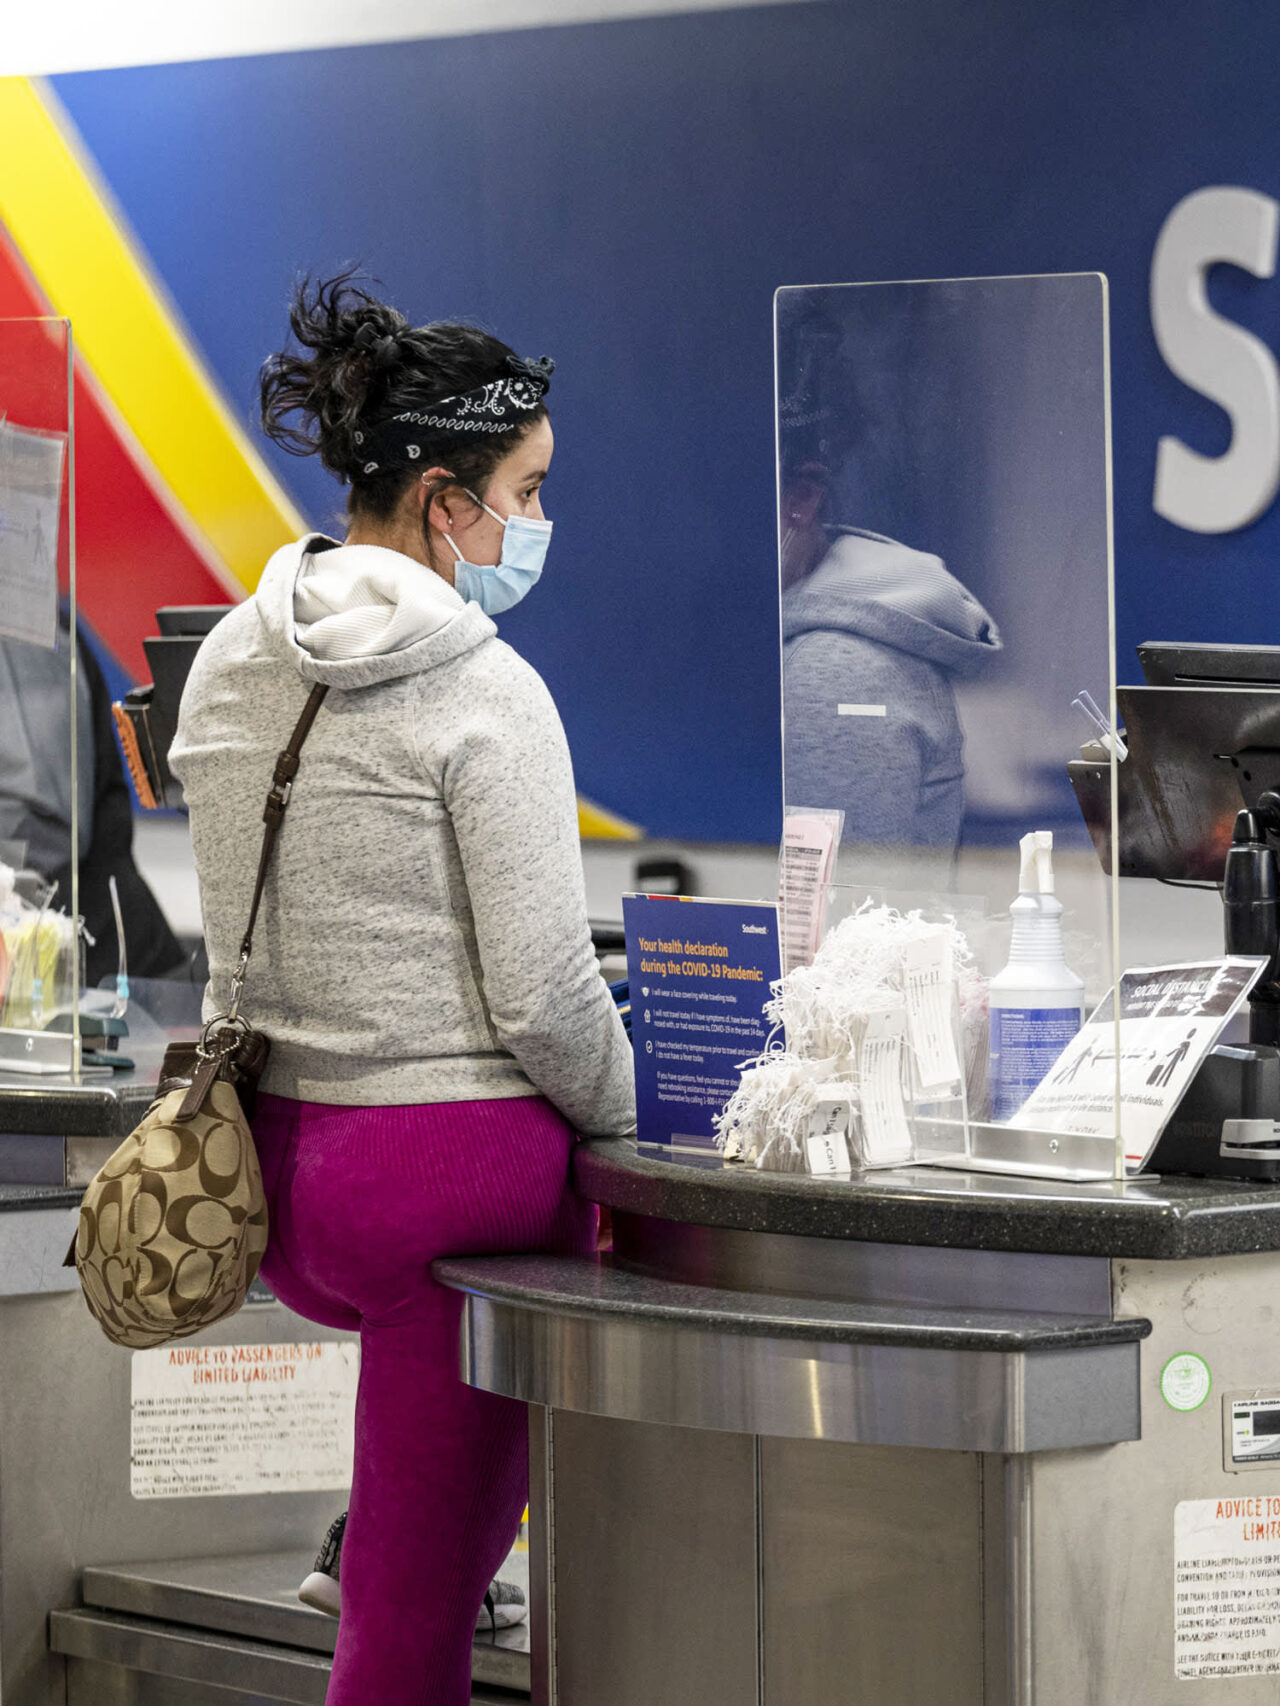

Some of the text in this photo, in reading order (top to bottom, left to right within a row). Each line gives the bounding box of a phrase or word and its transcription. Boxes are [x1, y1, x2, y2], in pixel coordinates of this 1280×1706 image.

[742, 923, 767, 934] Southwest
[638, 937, 728, 957] Your health declaration
[640, 958, 764, 982] during the COVID-19 Pandemic:
[169, 1347, 209, 1366] ADVICE
[193, 1367, 239, 1384] LIMITED
[1216, 1499, 1262, 1519] ADVICE
[1266, 1498, 1280, 1517] TO
